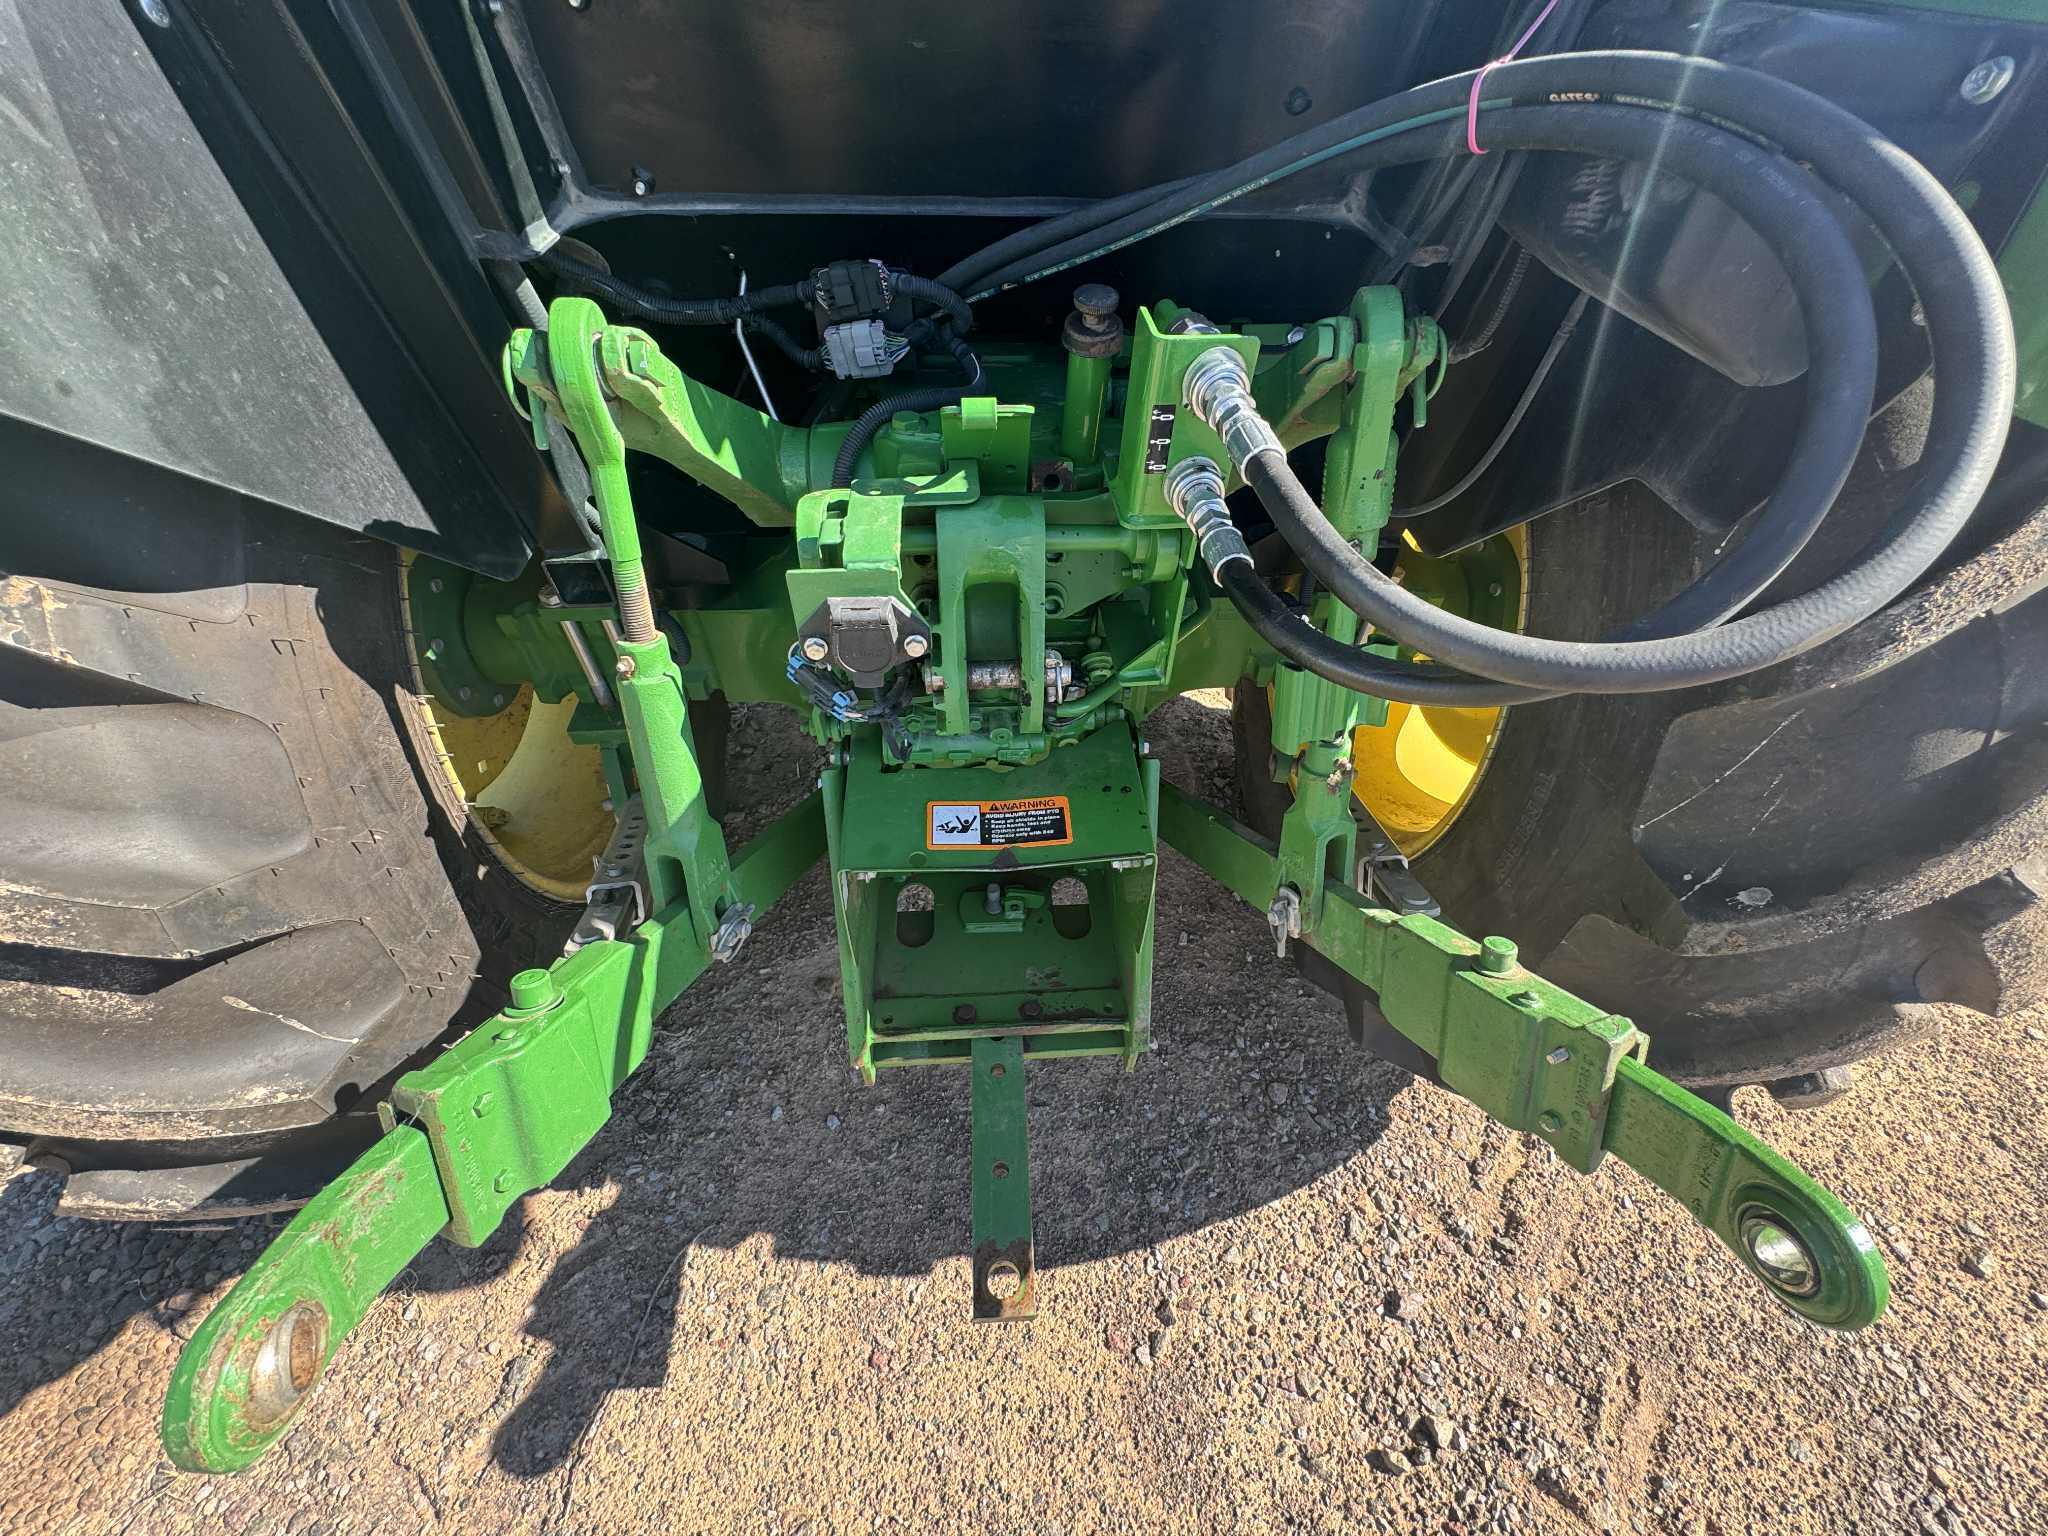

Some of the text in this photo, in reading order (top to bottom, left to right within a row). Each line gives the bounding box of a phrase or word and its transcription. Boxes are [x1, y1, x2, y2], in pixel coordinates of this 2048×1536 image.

[1548, 92, 1595, 102] GATES
[1000, 800, 1056, 810] WARNING
[1005, 810, 1027, 818] INJURY
[1028, 808, 1046, 816] FROM
